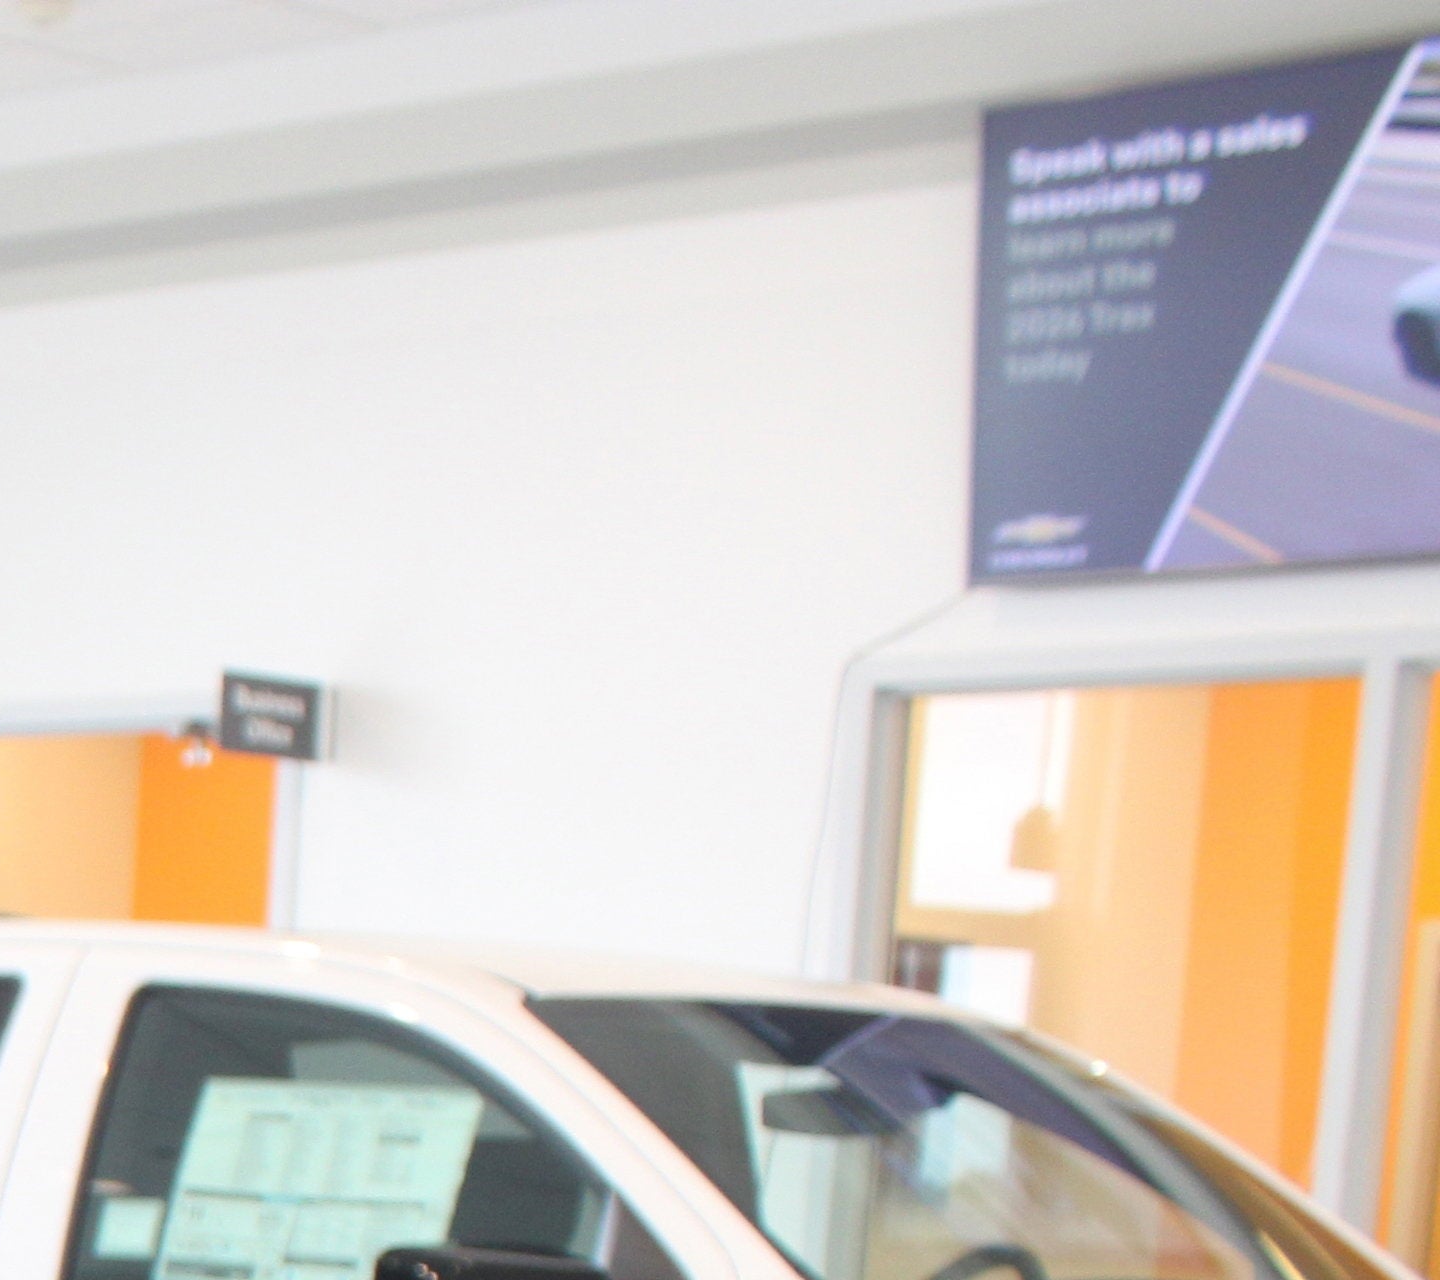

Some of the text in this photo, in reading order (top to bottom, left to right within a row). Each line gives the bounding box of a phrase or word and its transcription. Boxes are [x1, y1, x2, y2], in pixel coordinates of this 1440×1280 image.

[1009, 114, 1310, 184] Speak with a sales
[1007, 171, 1208, 224] associate to
[1090, 217, 1176, 250] more
[1008, 261, 1158, 302] about the
